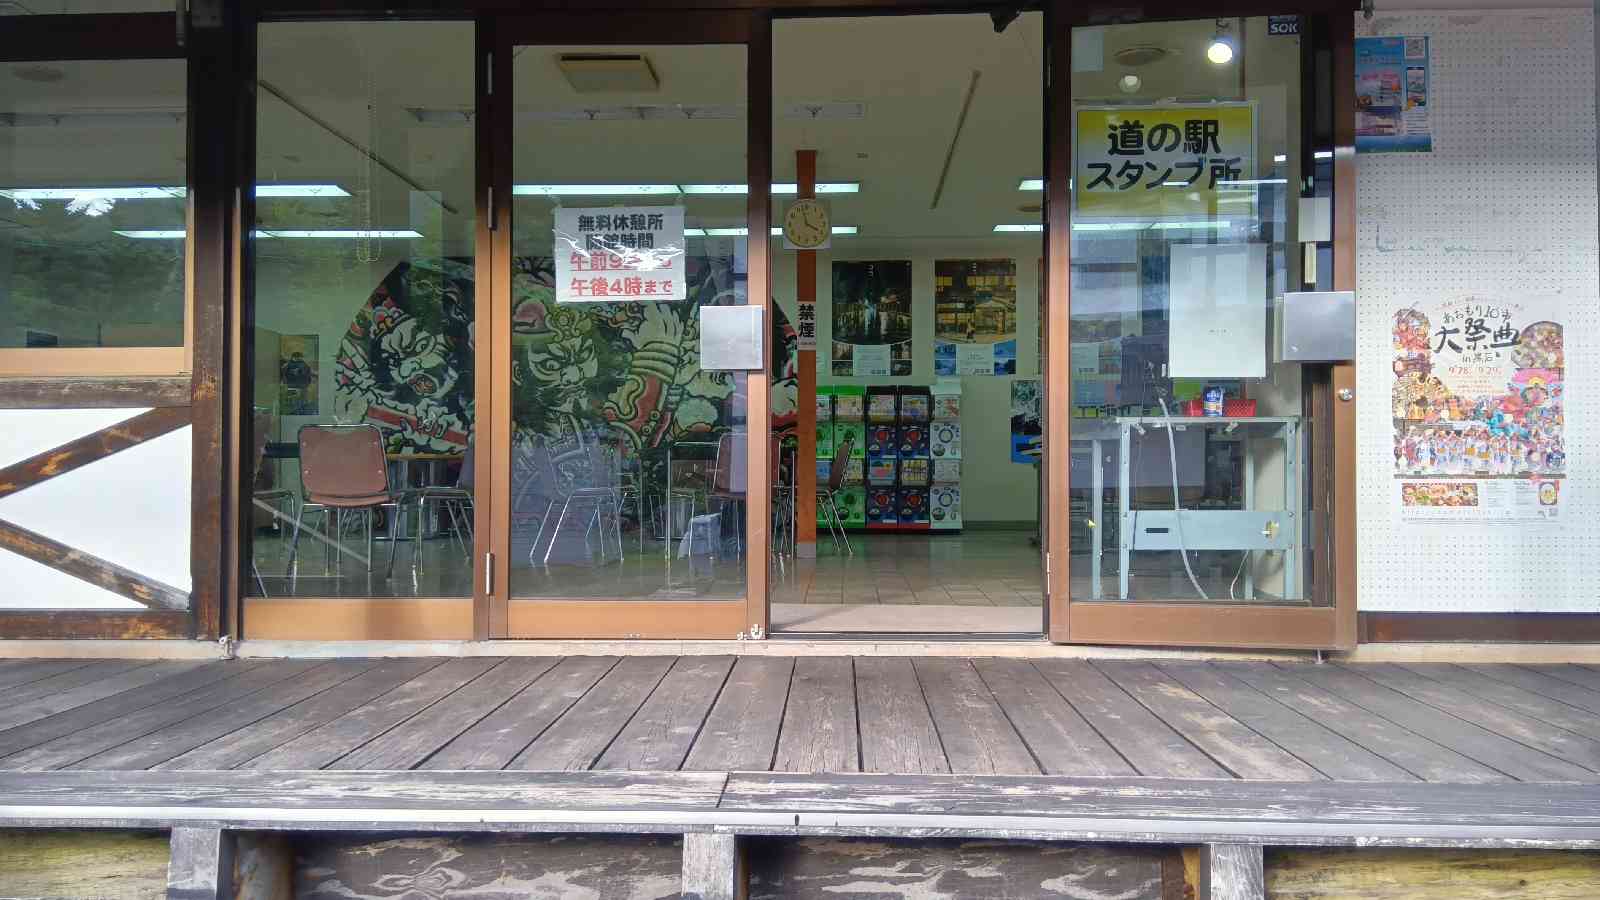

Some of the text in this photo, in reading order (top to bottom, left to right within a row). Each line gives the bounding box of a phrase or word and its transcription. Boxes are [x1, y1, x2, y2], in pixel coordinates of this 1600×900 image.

[1107, 119, 1222, 156] 道の駅
[1086, 156, 1241, 190] スタンプ所
[578, 213, 664, 231] 無料休憩所
[570, 276, 673, 296] 午後4時まで
[799, 303, 815, 338] 禁煙
[1433, 317, 1521, 356] 大祭典
